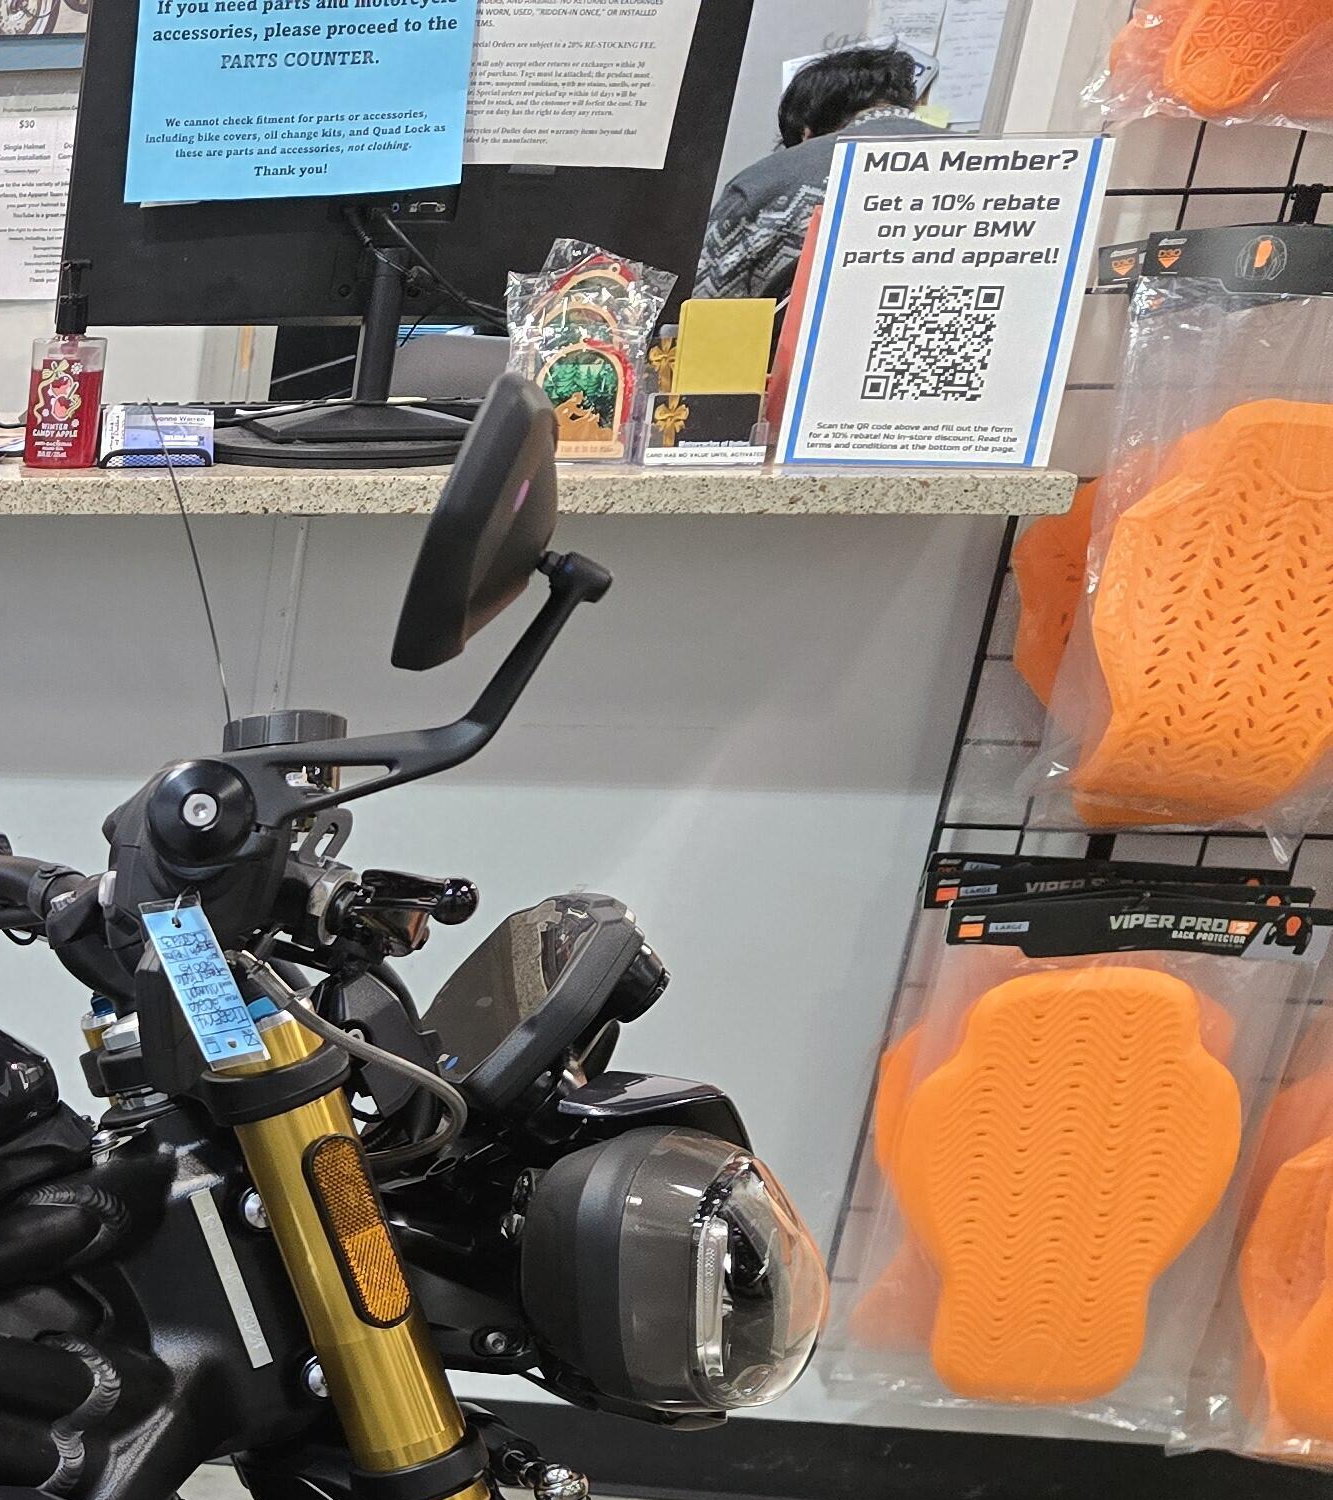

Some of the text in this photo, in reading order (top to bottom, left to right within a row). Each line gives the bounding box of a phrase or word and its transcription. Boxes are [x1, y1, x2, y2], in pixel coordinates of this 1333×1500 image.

[156, 0, 317, 18] If you need parts
[486, 9, 510, 17] WORN,
[153, 17, 458, 43] accessories, please proceed to the
[221, 51, 379, 69] PARTS COUNTER.
[166, 110, 428, 127] We cannot check fitment for parts or accessories,
[146, 132, 195, 145] including
[198, 131, 220, 142] bike
[223, 131, 261, 142] covers,
[264, 130, 277, 139] oil
[281, 129, 318, 141] change
[321, 127, 346, 139] kits,
[349, 126, 370, 136] and
[373, 126, 401, 137] Quad
[405, 124, 431, 134] Lock
[176, 141, 412, 158] these are parts and accessories, not clothing.
[864, 150, 1078, 172] MOA Member?
[254, 164, 328, 178] Thank you!
[863, 194, 1060, 212] Get a 10% rebate
[877, 221, 1035, 241] on your BMW
[843, 248, 1059, 267] parts and apparel!
[56, 430, 77, 438] APPLE
[1110, 913, 1175, 930] VIPER
[1179, 916, 1228, 933] PRO
[1172, 931, 1245, 944] BACK PROTECTOR
